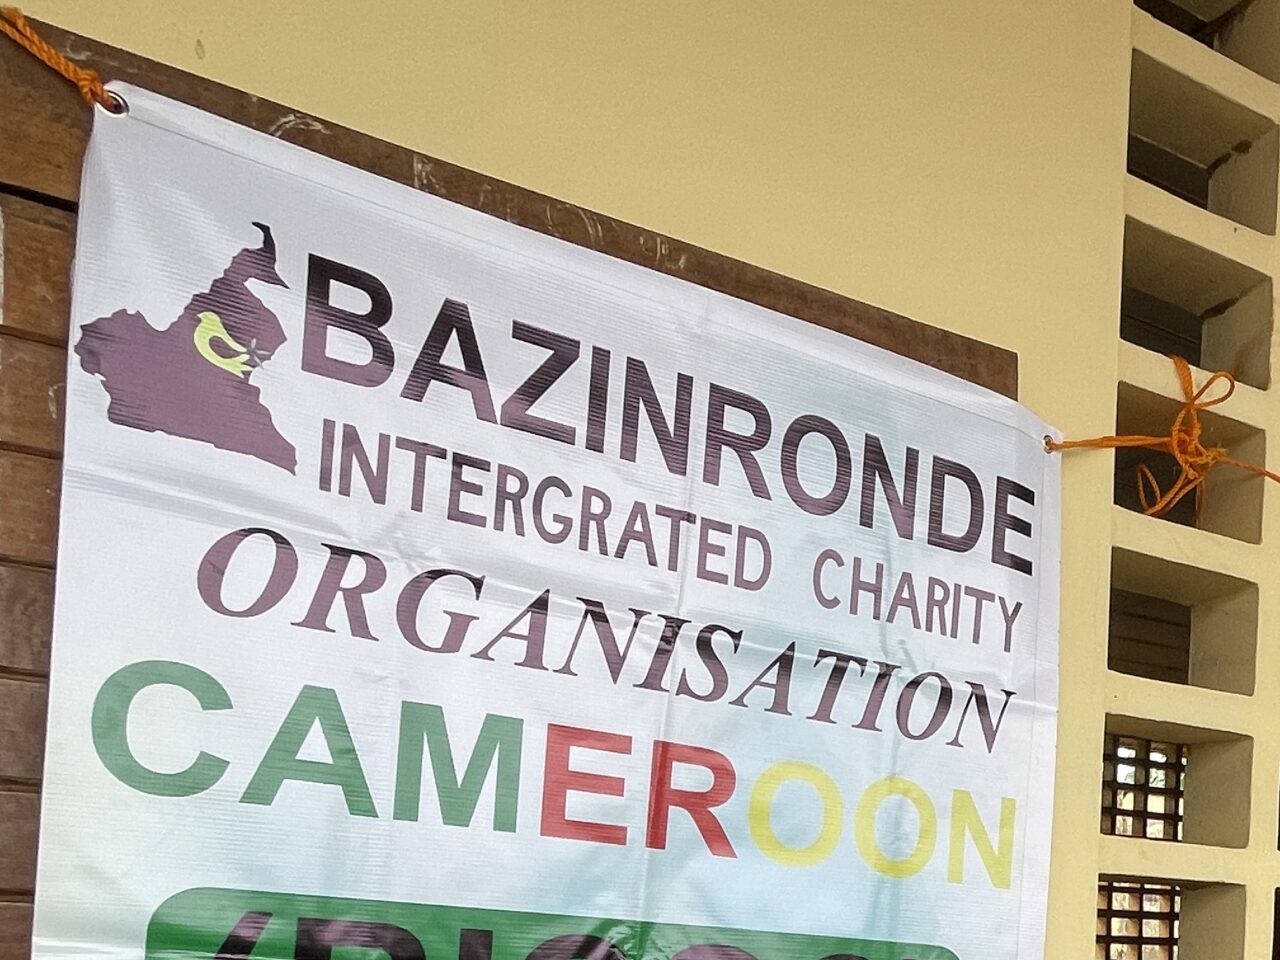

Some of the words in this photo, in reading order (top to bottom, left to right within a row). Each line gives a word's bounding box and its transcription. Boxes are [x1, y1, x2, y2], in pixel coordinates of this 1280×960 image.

[300, 253, 1035, 577] BAZINRONDE
[197, 525, 1017, 755] ORGANISATION
[319, 417, 773, 592] INTERGRATED
[812, 547, 1023, 654] CHARITY
[91, 659, 1017, 889] CAMEROON
